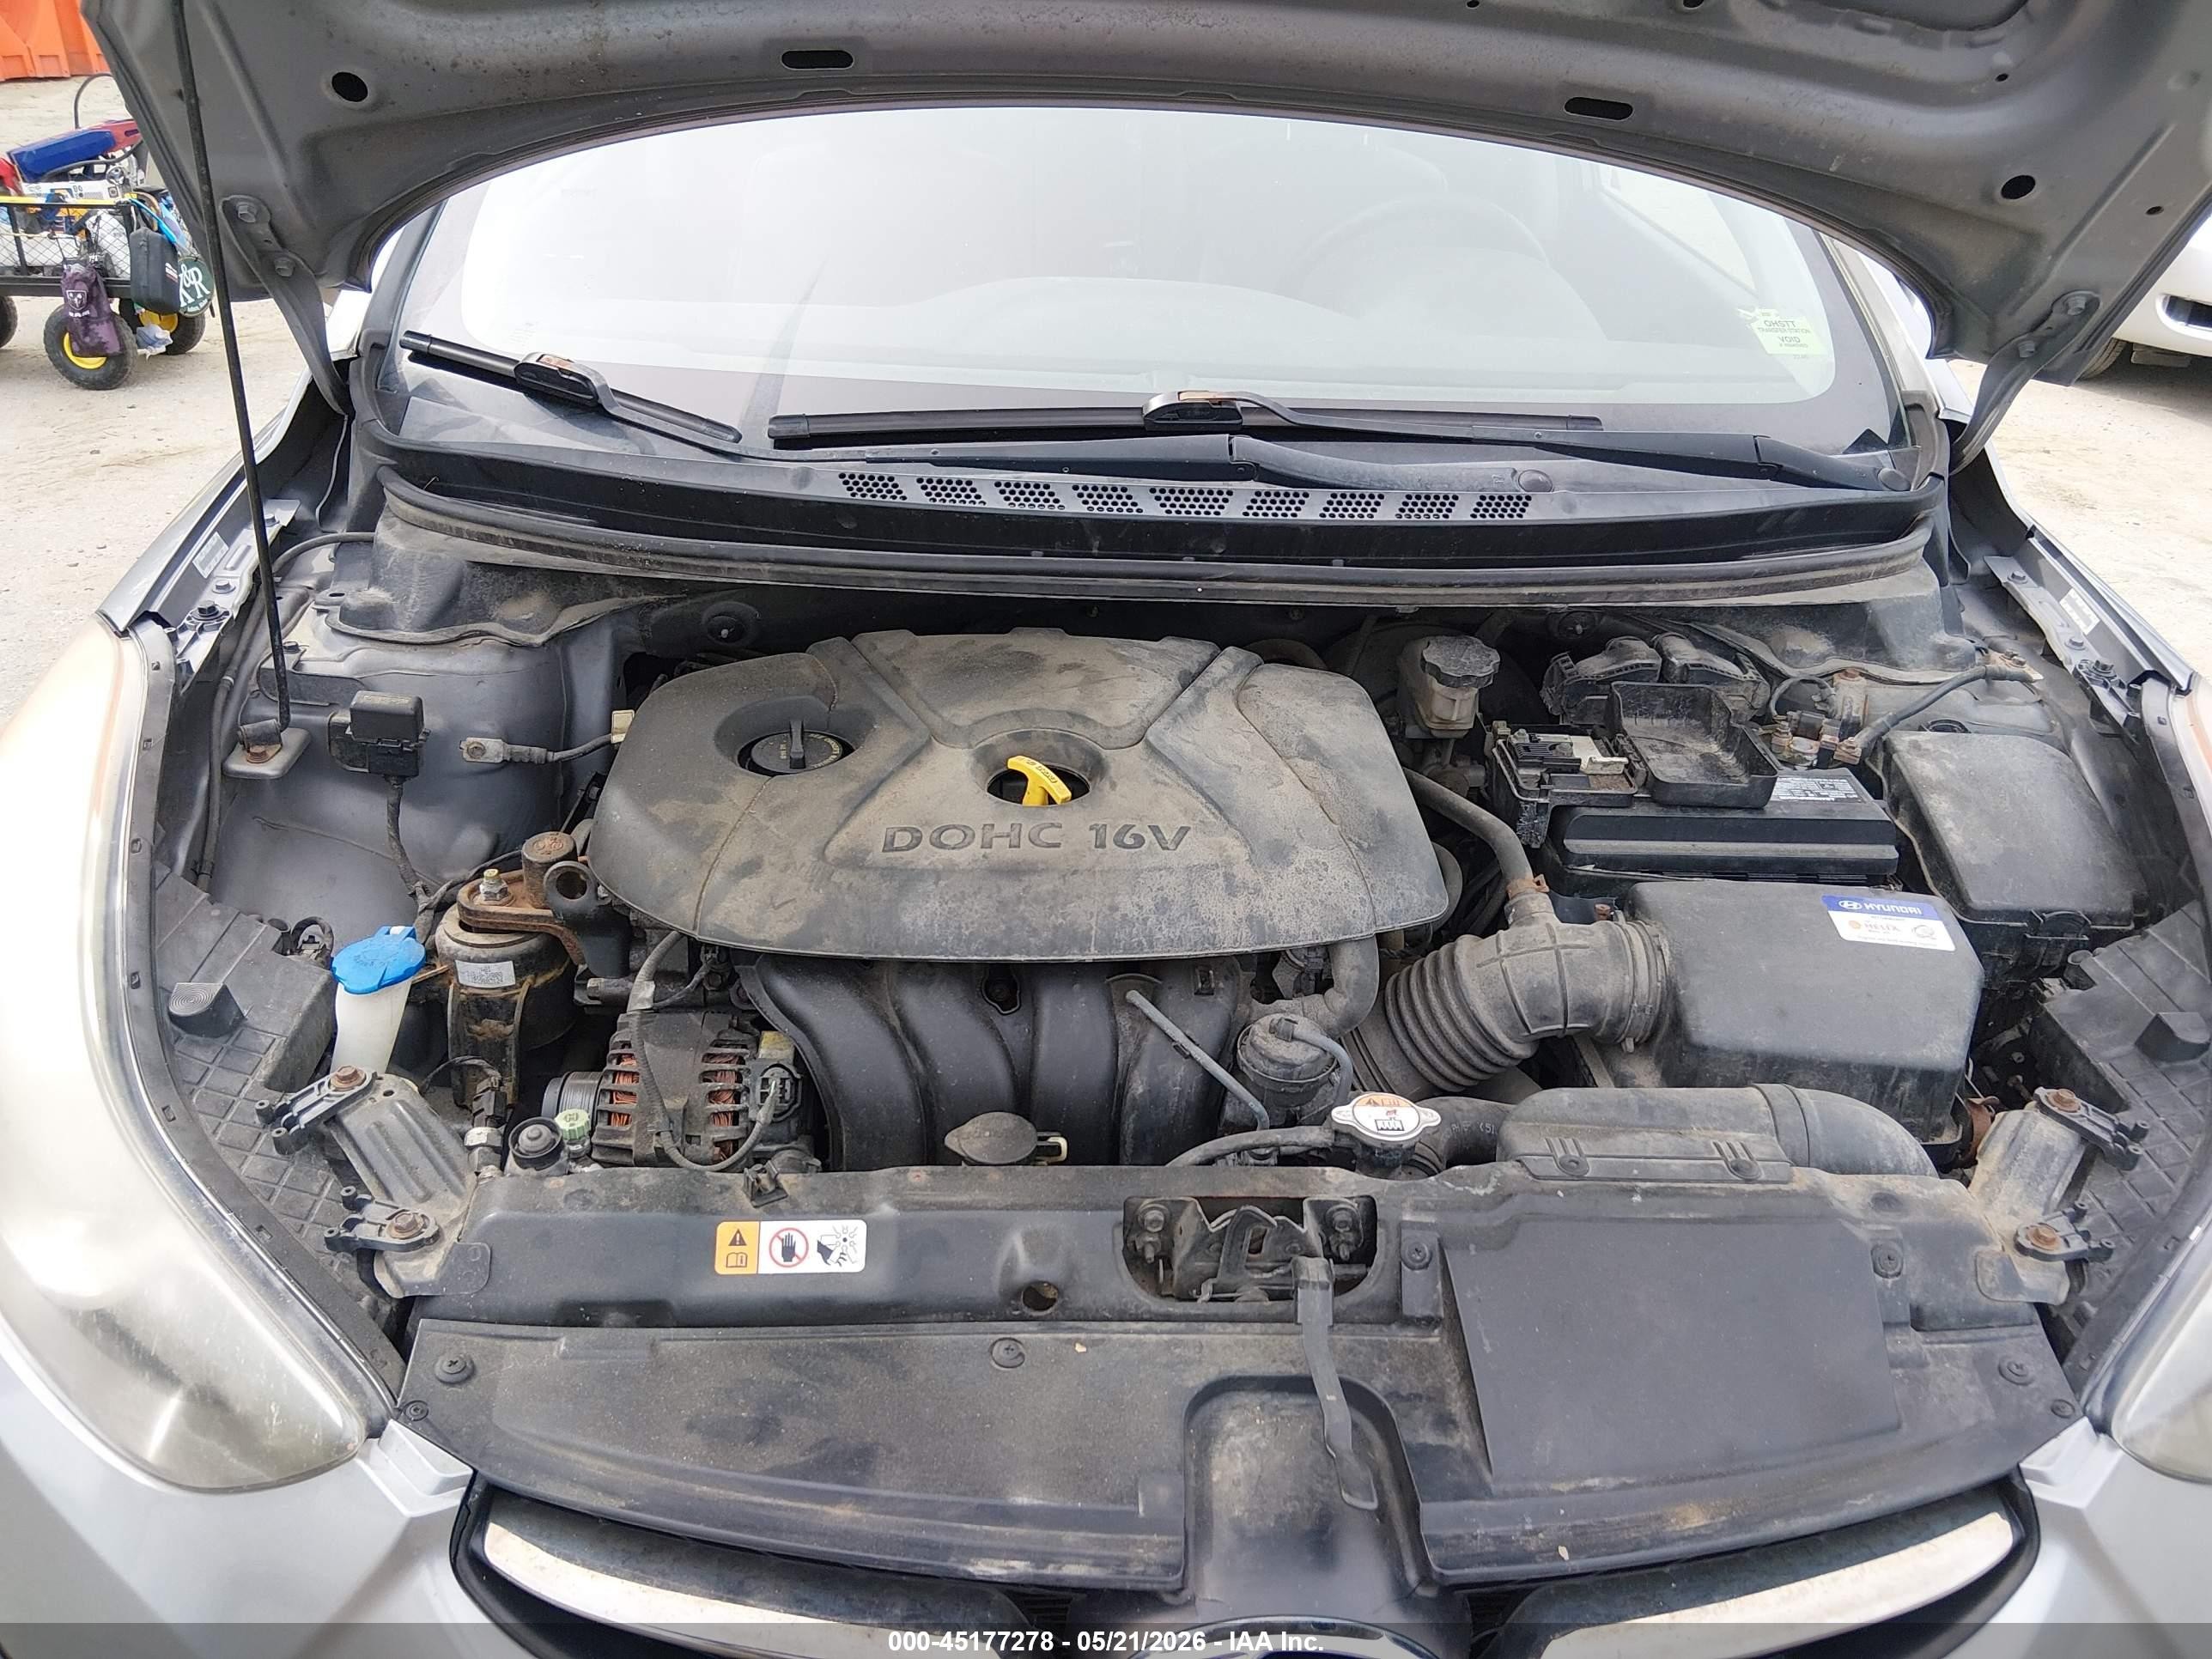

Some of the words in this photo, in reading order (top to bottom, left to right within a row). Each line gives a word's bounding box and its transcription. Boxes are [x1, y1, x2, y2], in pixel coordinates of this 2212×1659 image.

[881, 823, 1063, 853] DOHC
[1089, 823, 1192, 852] 16V
[1863, 902, 1923, 915] HYUNDAI
